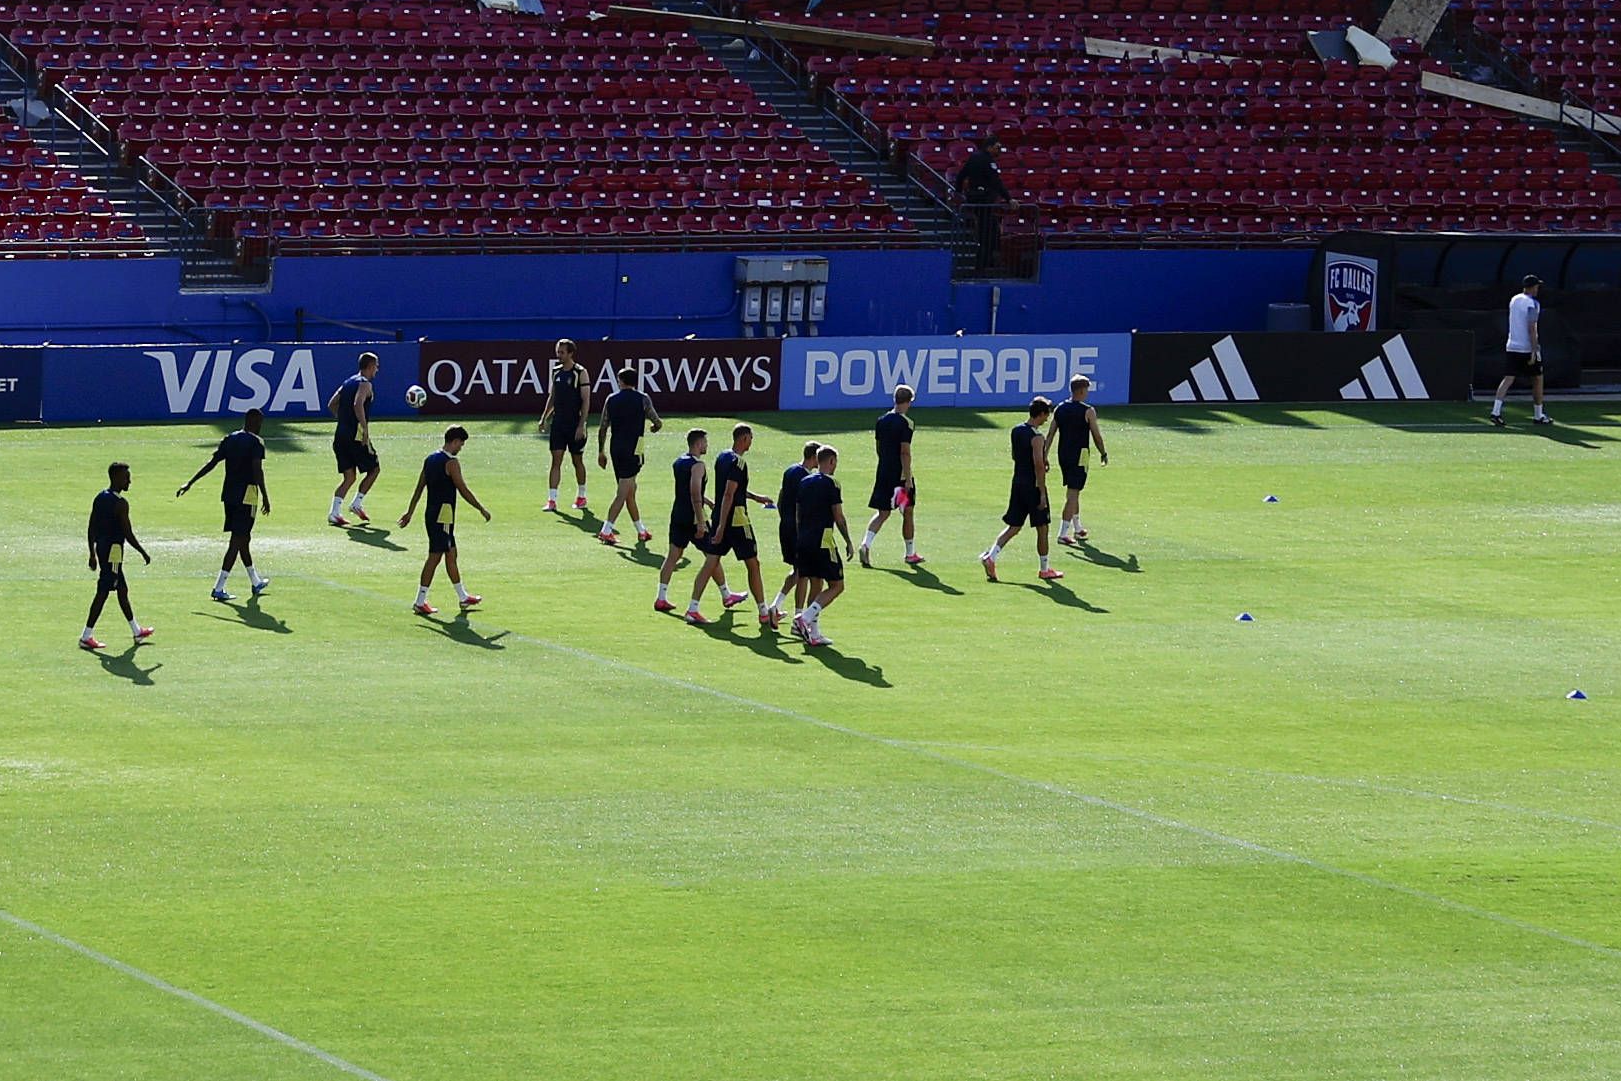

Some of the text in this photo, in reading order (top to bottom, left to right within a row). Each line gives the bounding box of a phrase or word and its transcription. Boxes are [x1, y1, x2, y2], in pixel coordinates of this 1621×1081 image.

[1330, 267, 1372, 295] FC DALLAS
[143, 348, 321, 413] VISA
[427, 358, 559, 405] QATA
[804, 347, 1098, 396] POWERADE
